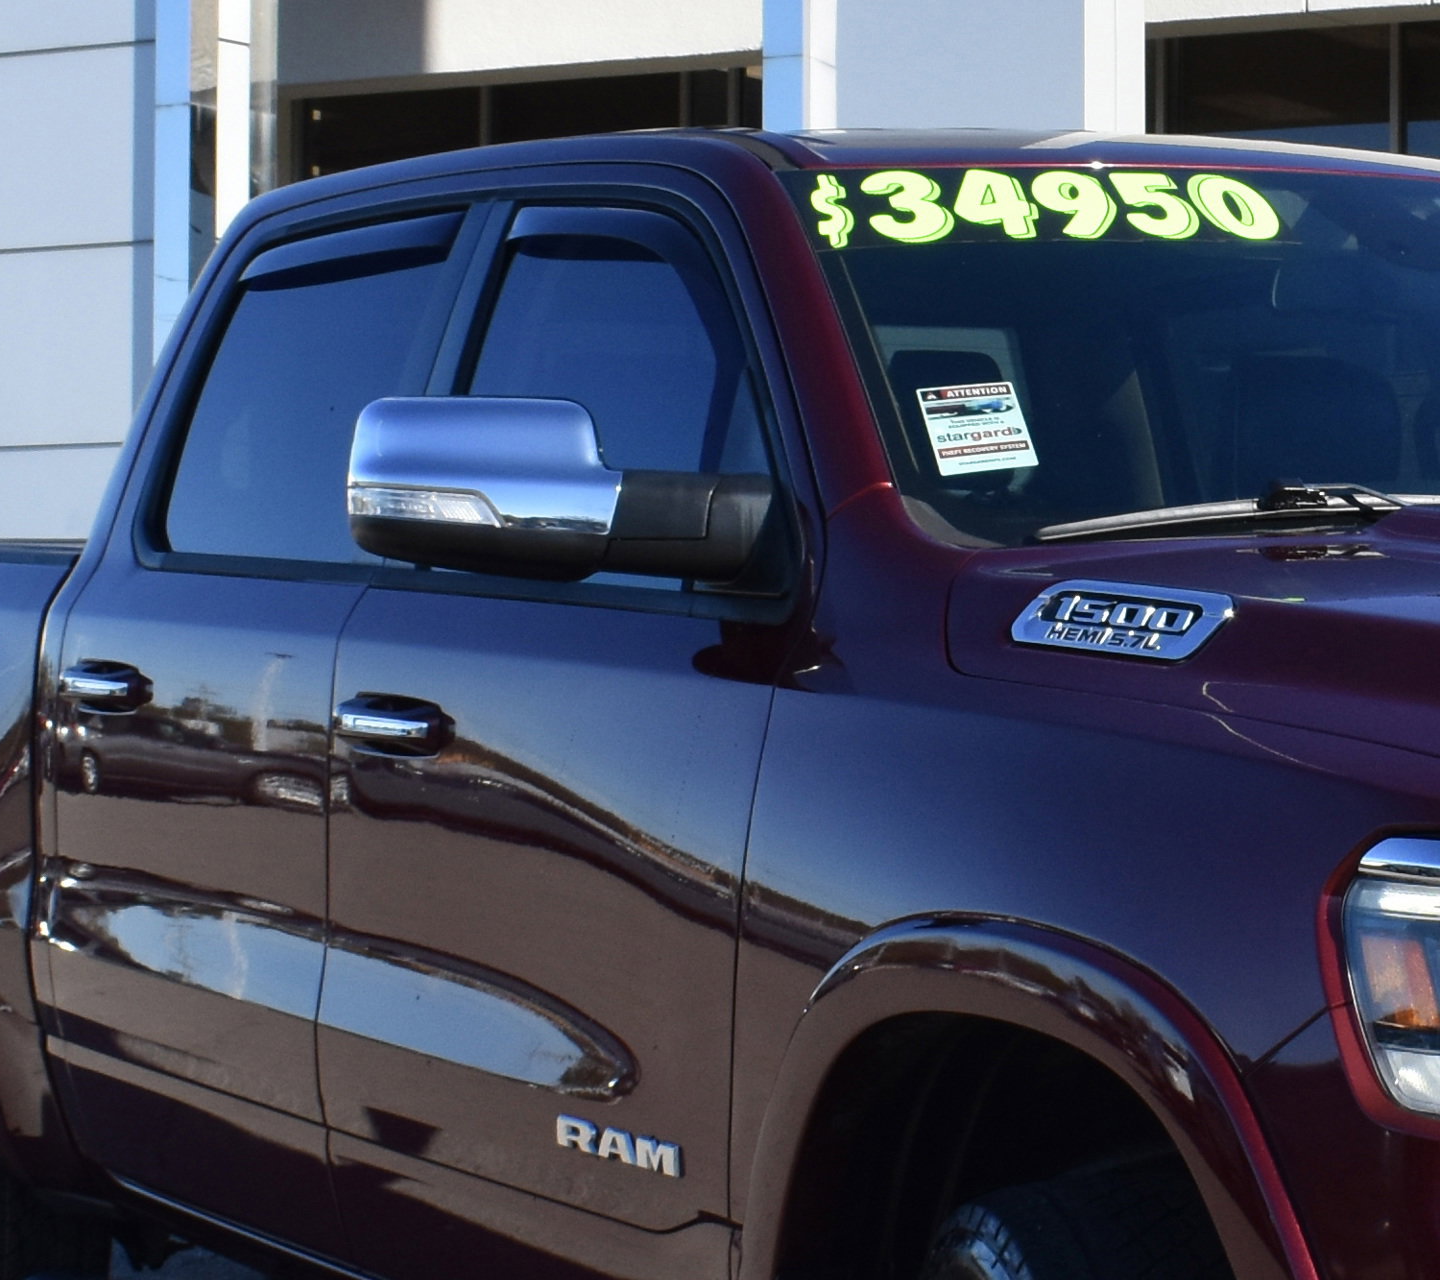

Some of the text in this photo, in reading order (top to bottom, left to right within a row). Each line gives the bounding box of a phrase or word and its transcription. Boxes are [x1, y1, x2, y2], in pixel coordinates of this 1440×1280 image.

[809, 168, 1281, 249] $34950
[946, 386, 1007, 398] ATTENTION
[936, 426, 1013, 443] stargard
[1054, 595, 1195, 633] 1500
[1047, 623, 1106, 644] HEMI
[556, 1113, 681, 1179] RAM
